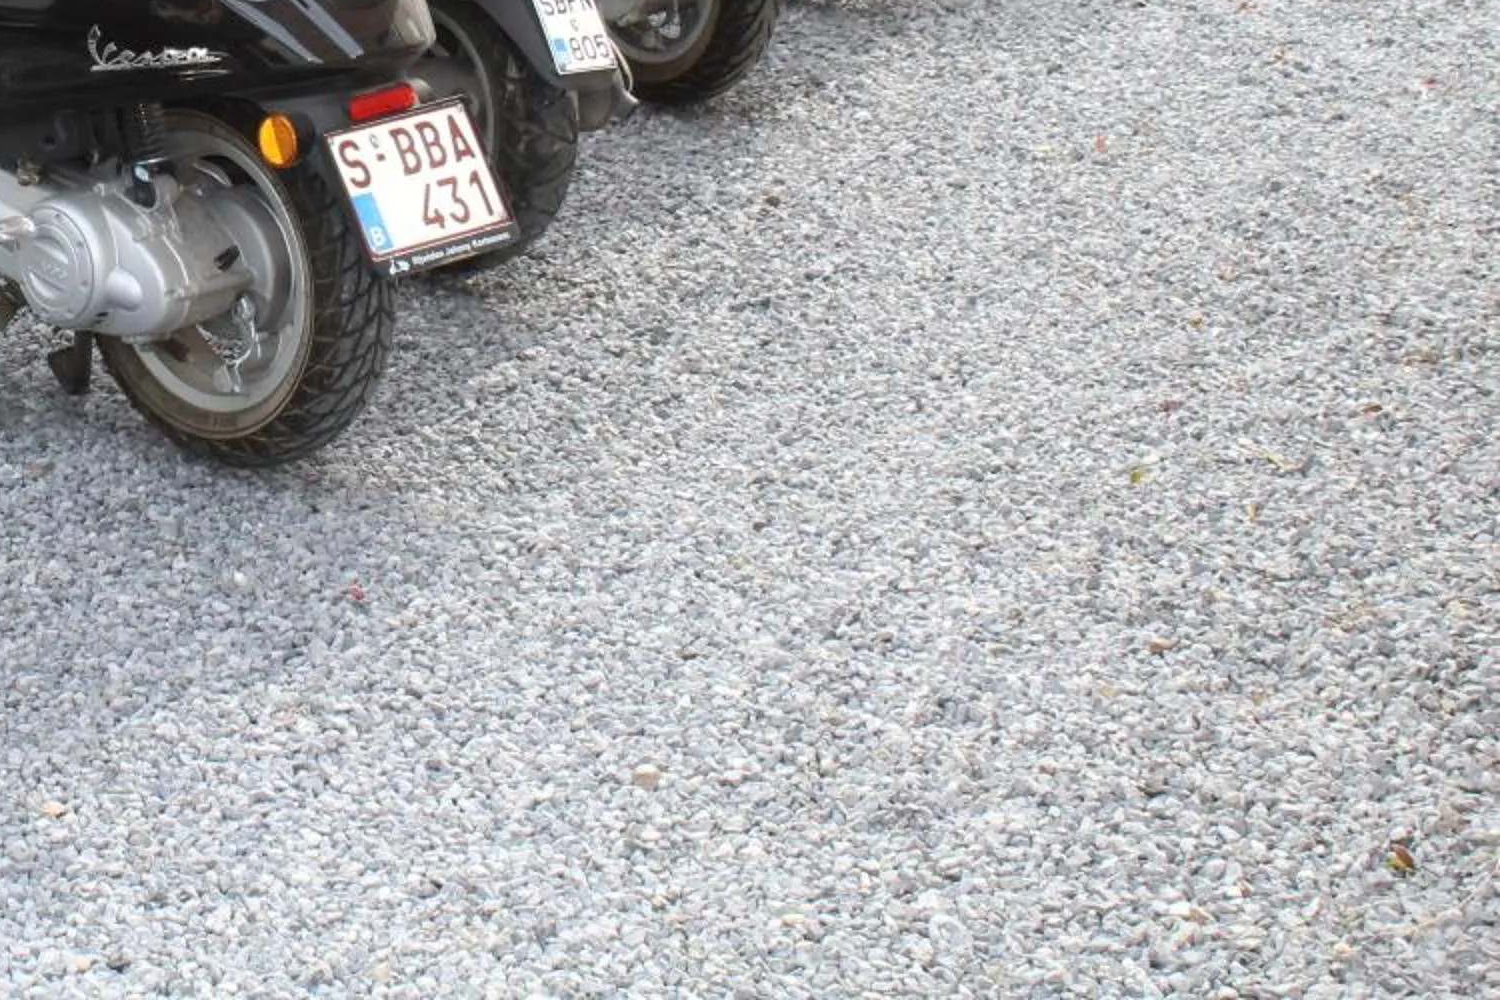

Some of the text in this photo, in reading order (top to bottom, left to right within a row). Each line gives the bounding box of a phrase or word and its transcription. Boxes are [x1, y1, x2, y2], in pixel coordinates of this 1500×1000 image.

[87, 23, 223, 72] Vespa
[569, 34, 610, 61] 805
[422, 168, 495, 230] 431
[367, 225, 387, 249] B
